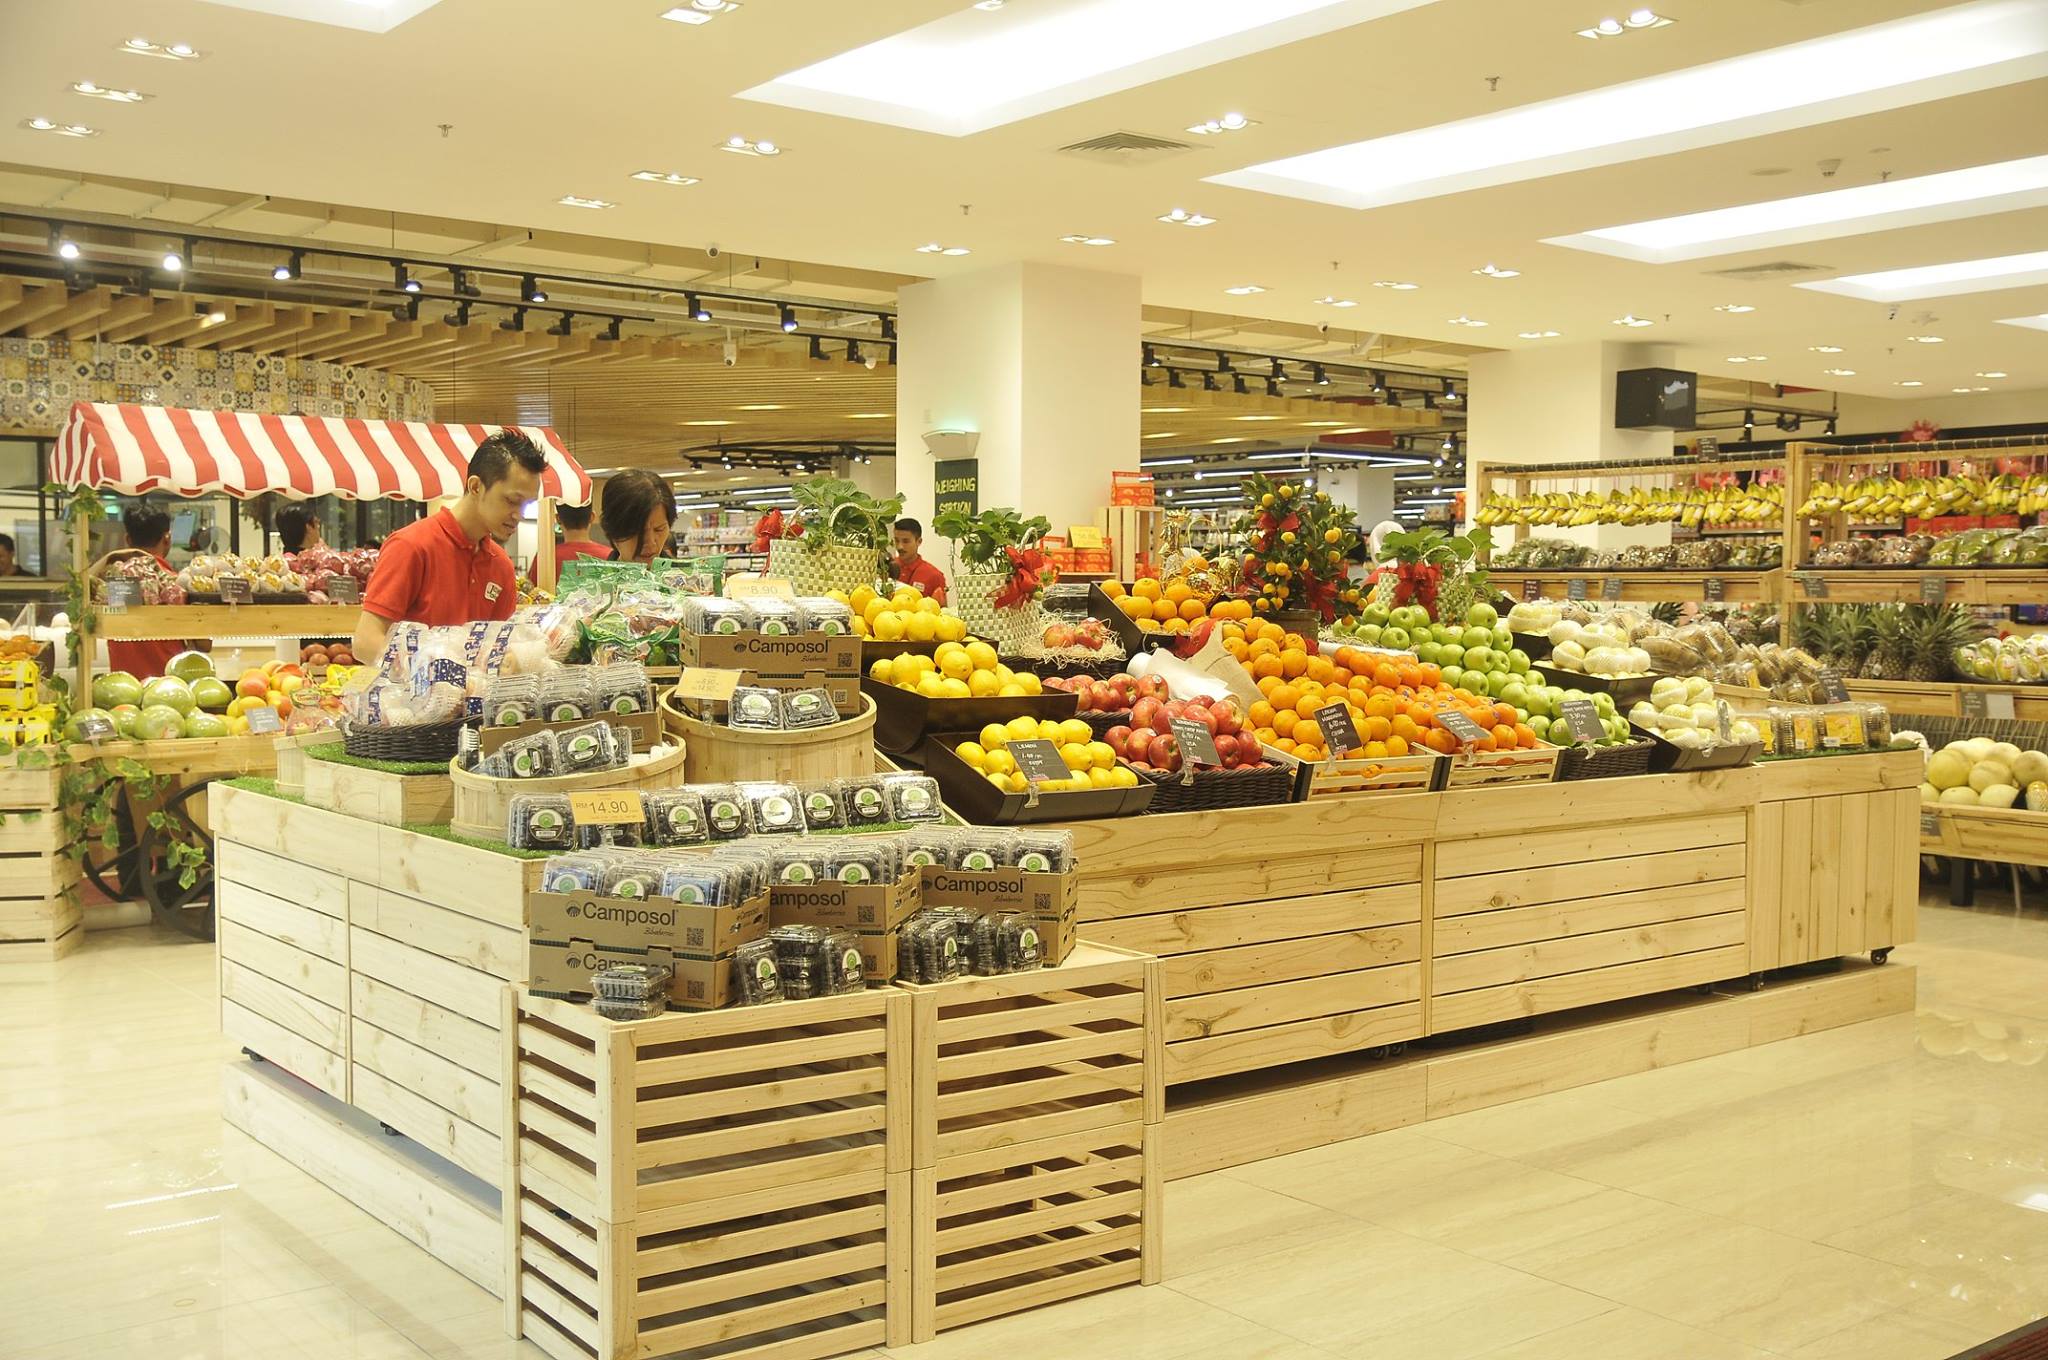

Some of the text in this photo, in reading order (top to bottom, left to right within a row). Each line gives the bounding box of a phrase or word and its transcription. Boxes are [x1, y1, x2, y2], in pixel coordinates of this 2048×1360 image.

[751, 585, 777, 594] 8.90
[748, 639, 829, 656] Camposol
[589, 800, 628, 814] 14.90
[934, 875, 1023, 896] Camposol
[770, 889, 846, 909] amposol
[583, 902, 676, 926] Camposol
